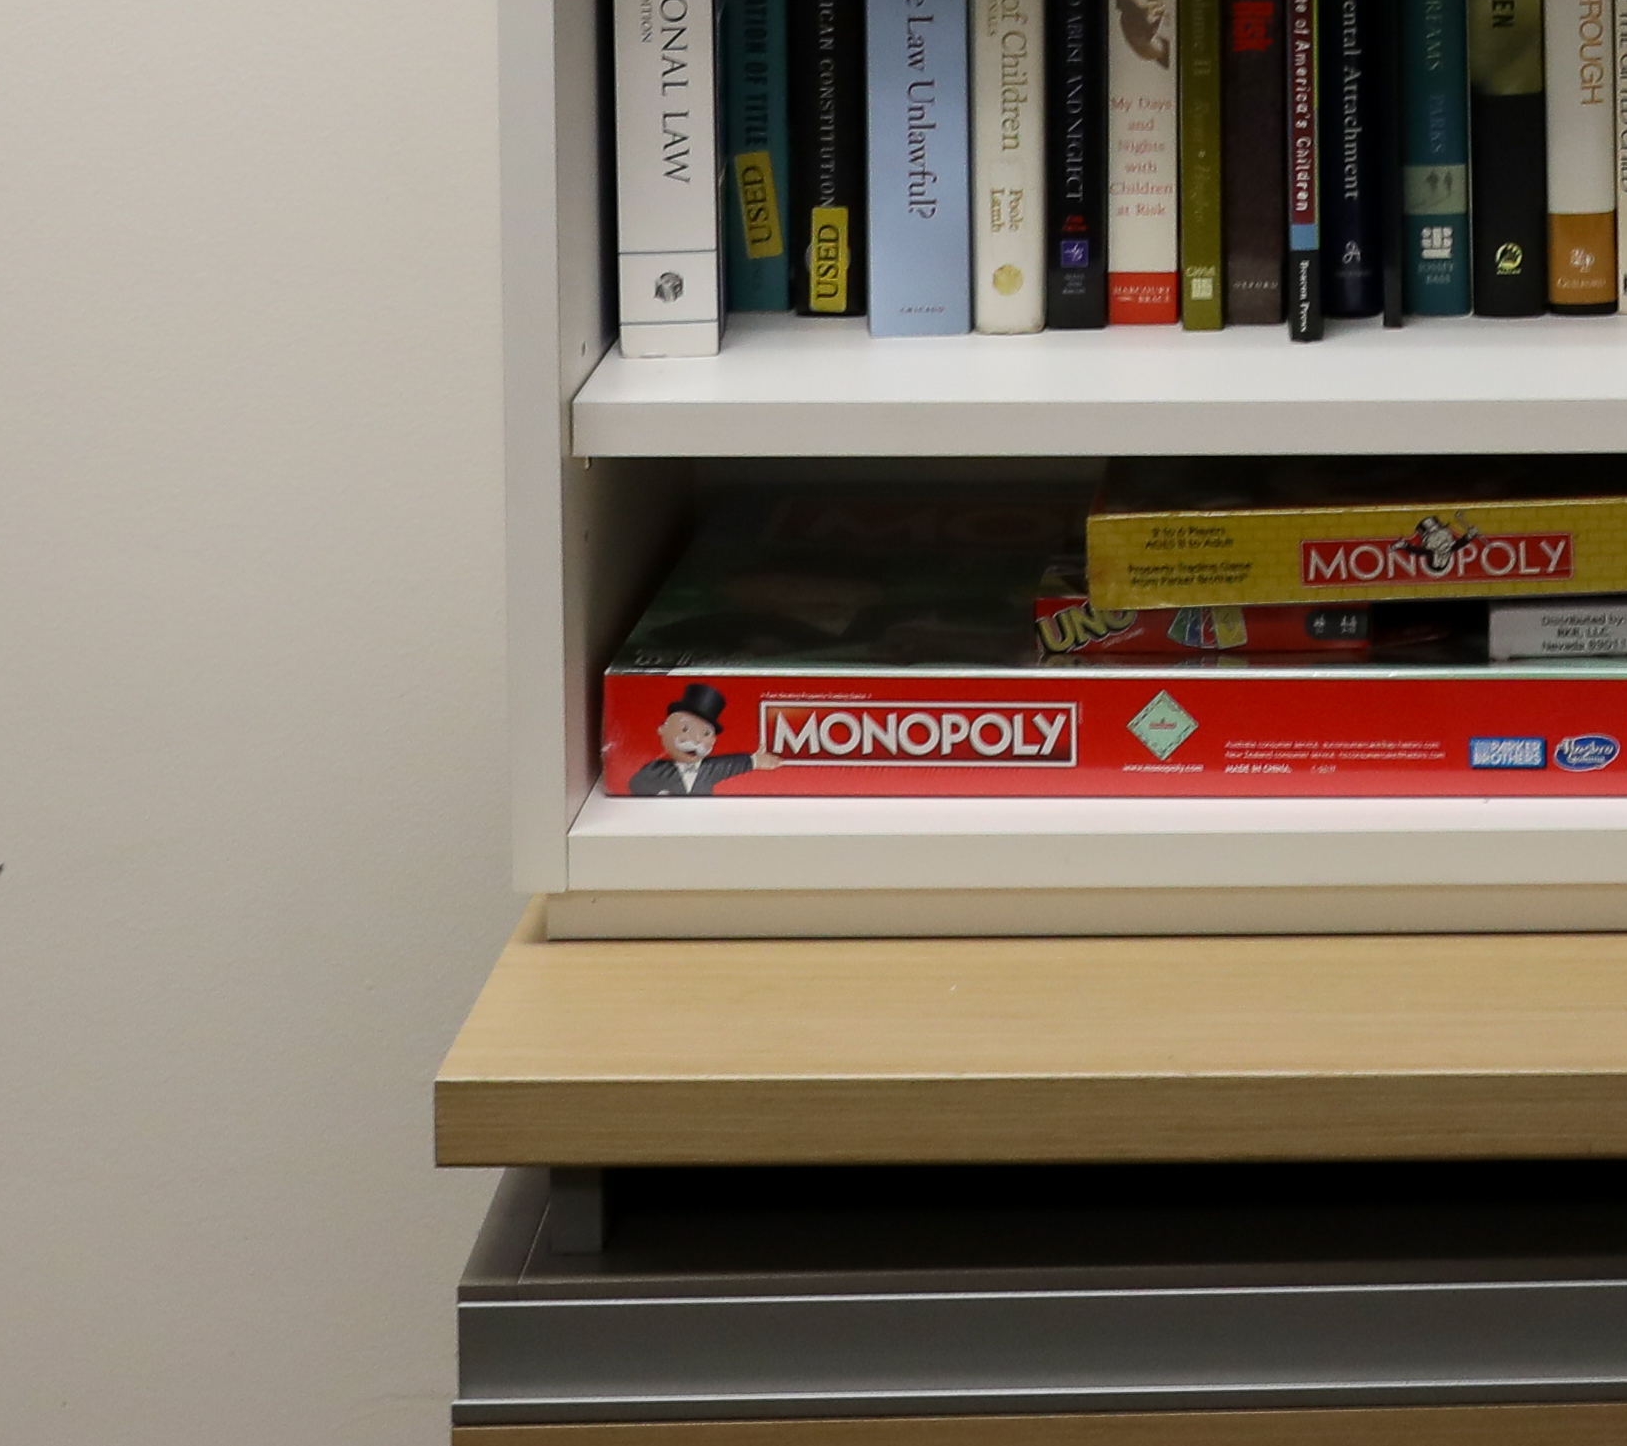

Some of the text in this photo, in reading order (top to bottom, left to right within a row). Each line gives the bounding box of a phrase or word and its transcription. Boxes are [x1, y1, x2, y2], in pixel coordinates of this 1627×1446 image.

[907, 15, 935, 71] Law
[1292, 19, 1308, 35] of
[1294, 40, 1310, 129] America's
[662, 109, 690, 183] LAW
[907, 80, 937, 219] Unlawful?
[1342, 65, 1361, 200] Attachment
[1295, 137, 1311, 212] Children
[740, 166, 771, 244] USED
[990, 189, 1005, 233] Lamb
[816, 225, 839, 300] USED
[1307, 538, 1567, 583] MONOPOLY
[1036, 600, 1139, 653] UNO
[772, 710, 1068, 757] MONOPOLY
[1491, 739, 1539, 751] PARKER
[1557, 736, 1615, 760] Hasbro
